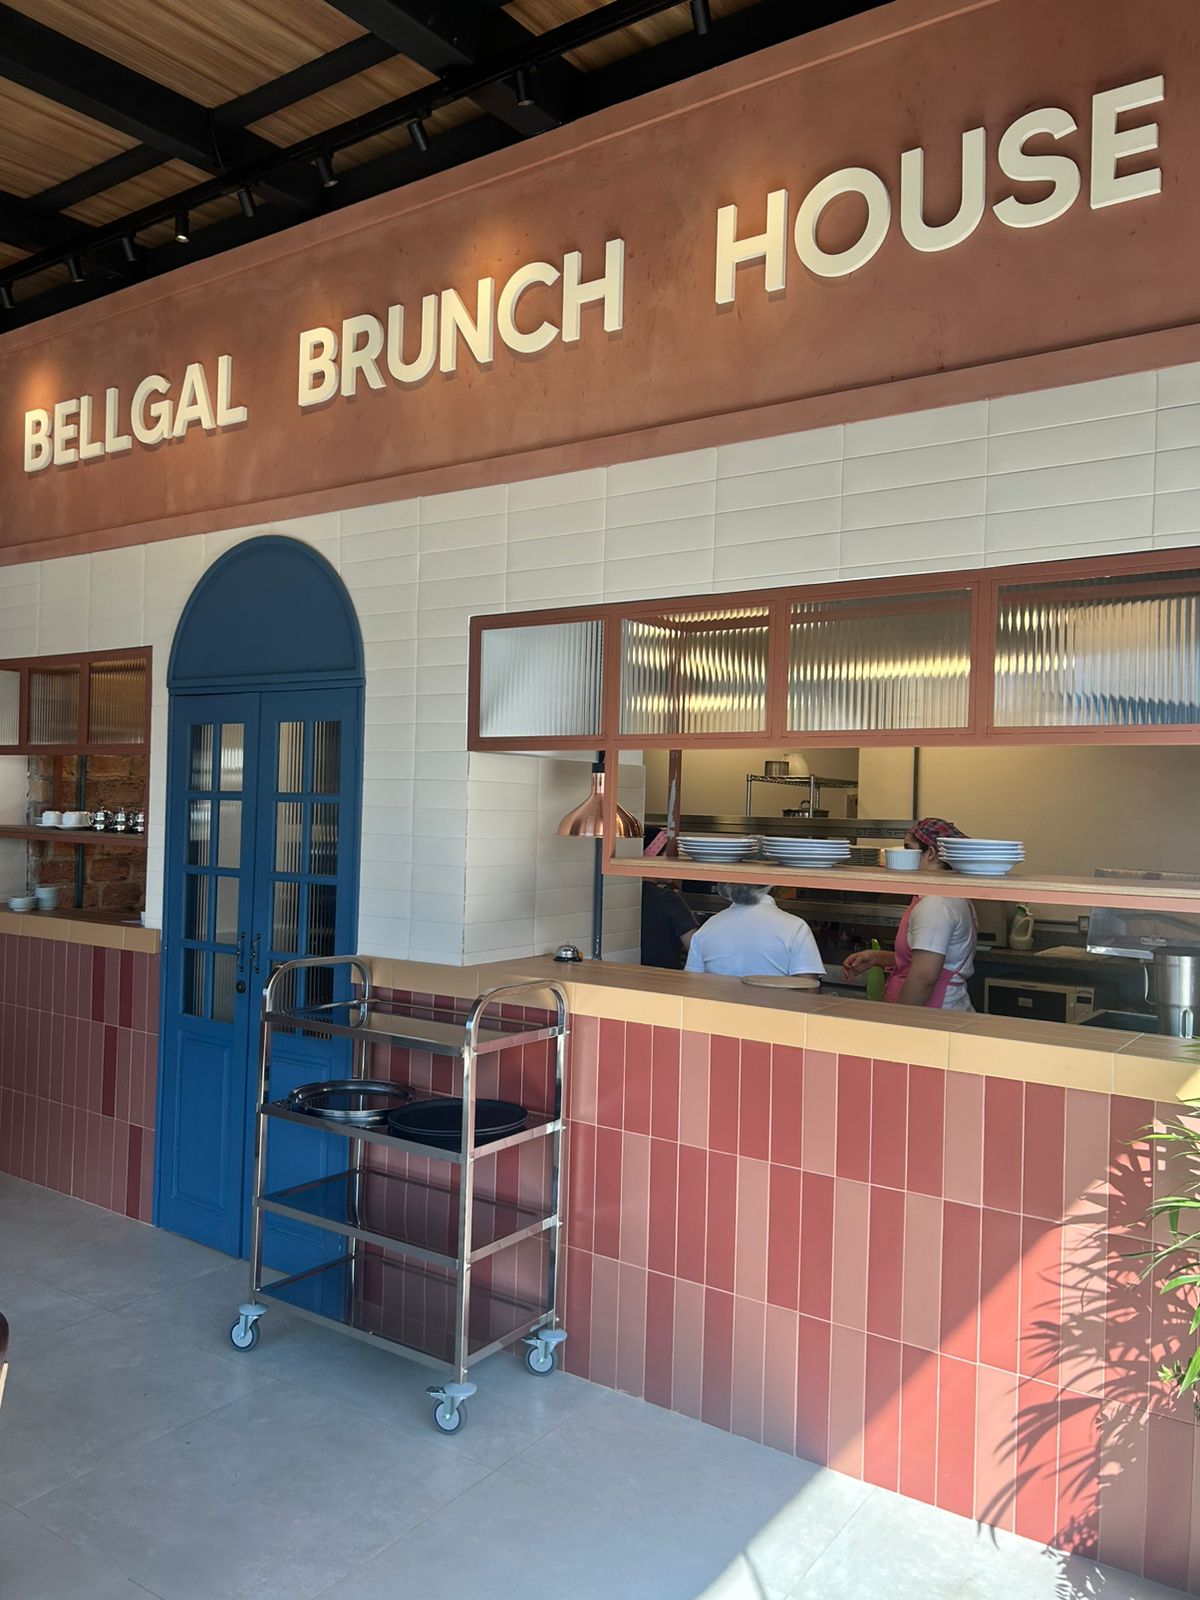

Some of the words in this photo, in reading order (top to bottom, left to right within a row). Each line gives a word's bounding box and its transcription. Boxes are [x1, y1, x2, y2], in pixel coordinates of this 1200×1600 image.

[24, 354, 248, 473] BELLGAL
[298, 238, 625, 407] BRUNCH
[715, 75, 1165, 305] HOUSE
